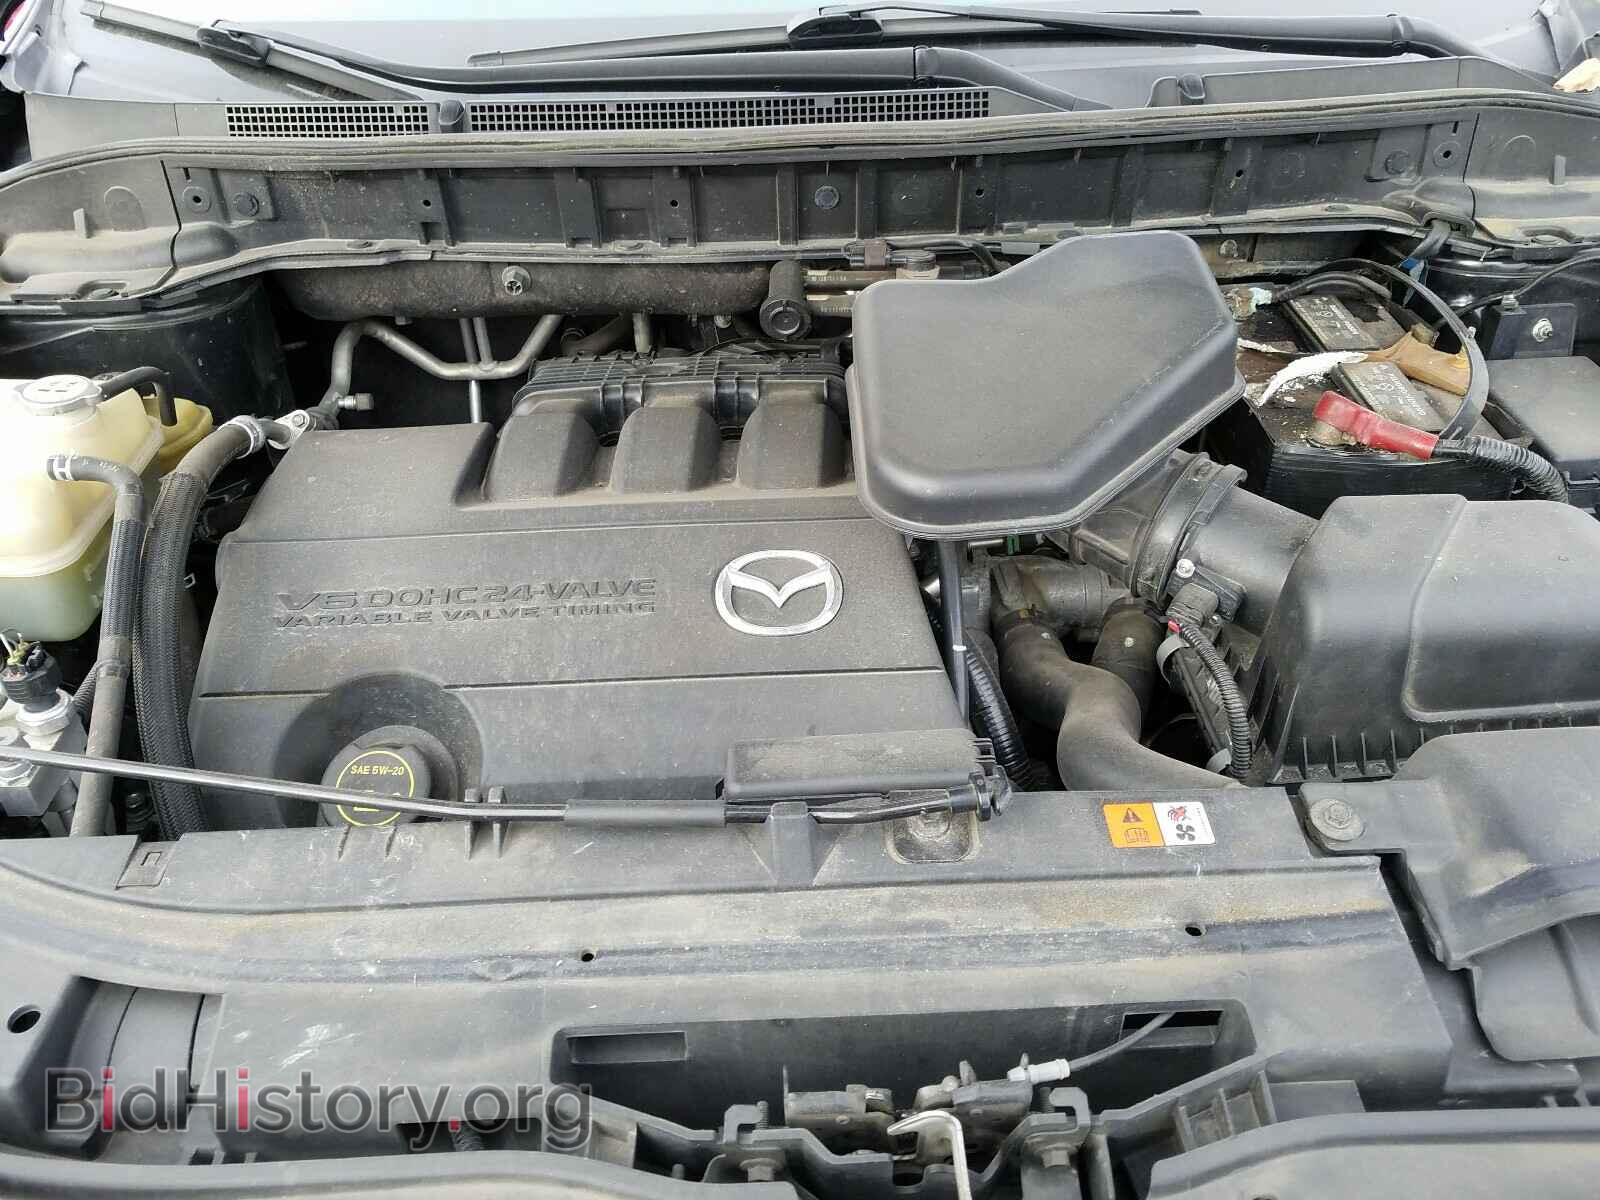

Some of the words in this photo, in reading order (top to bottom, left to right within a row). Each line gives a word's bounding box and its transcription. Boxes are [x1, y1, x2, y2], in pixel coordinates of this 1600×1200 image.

[275, 590, 359, 611] V6
[366, 585, 479, 609] DOHC
[484, 578, 657, 602] 24-VALVE
[273, 610, 434, 628] VARIABLE
[443, 605, 541, 623] VALVE
[549, 601, 657, 618] TIMING
[350, 765, 370, 775] SAE
[371, 765, 405, 776] 5W-20
